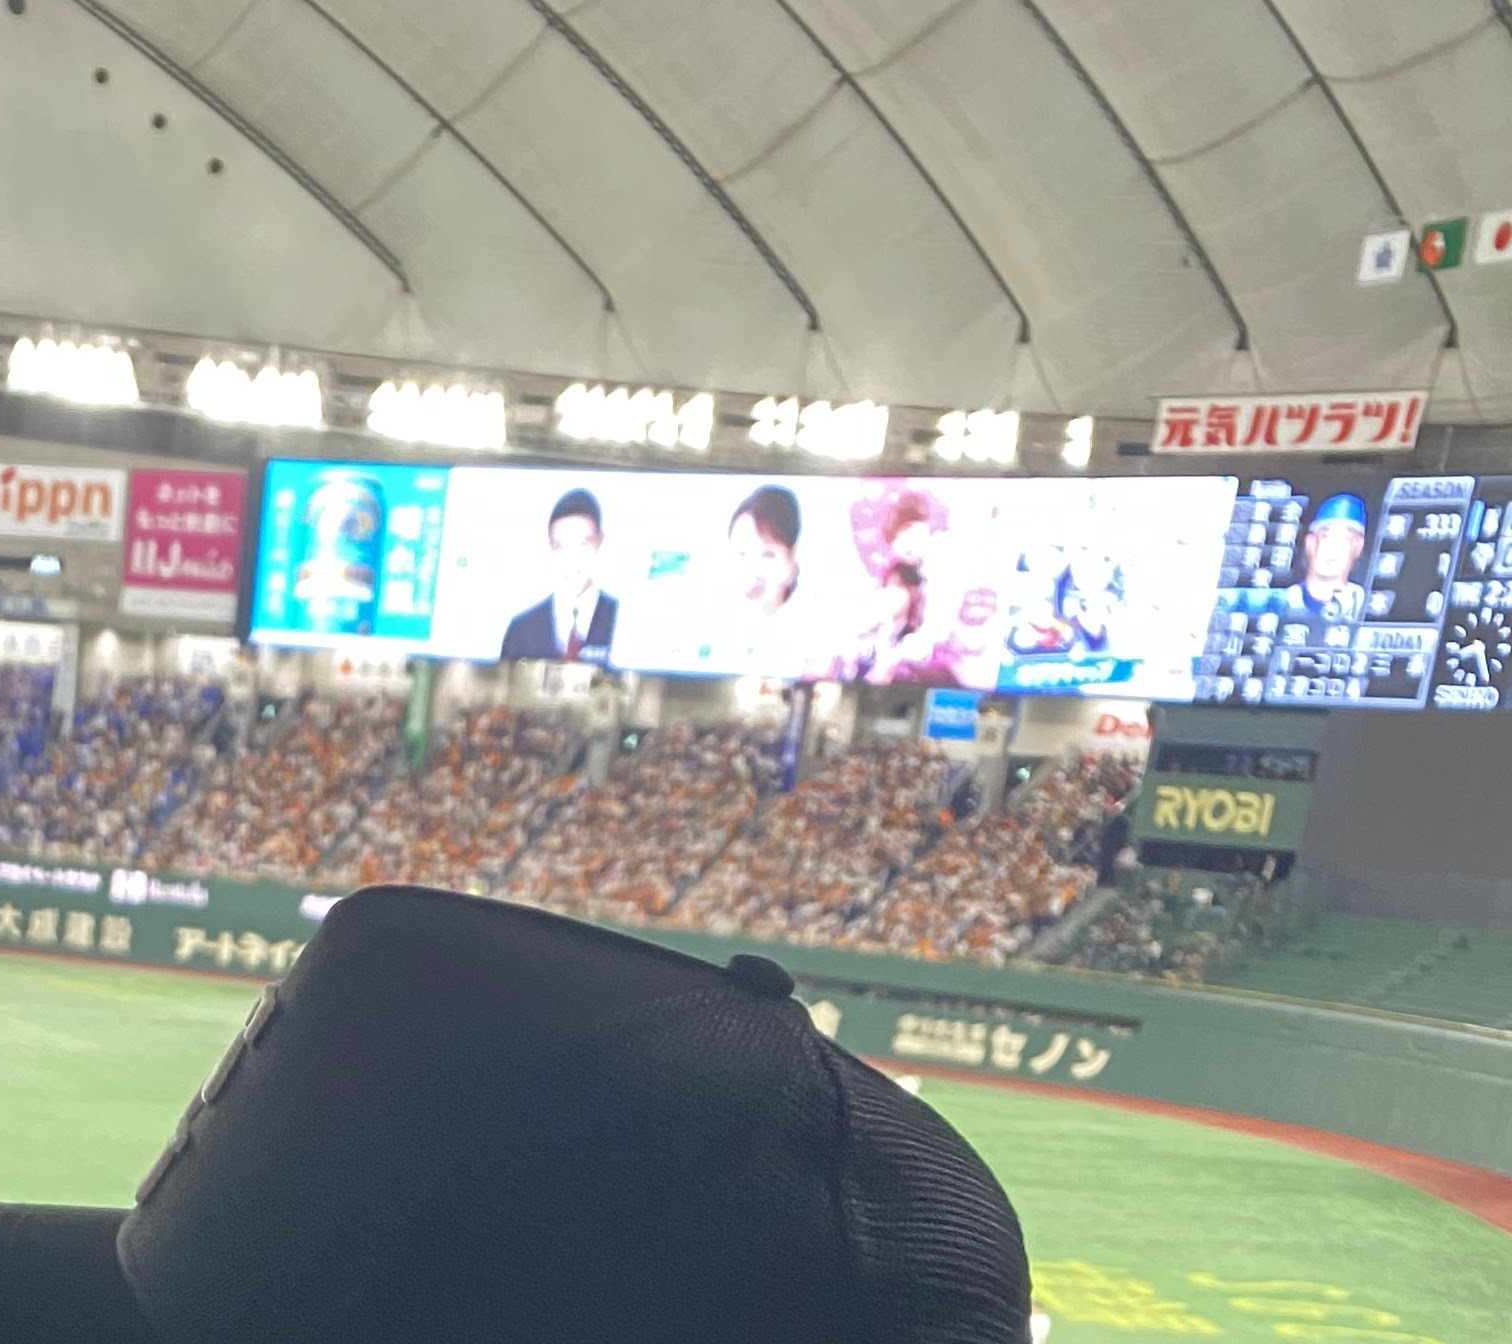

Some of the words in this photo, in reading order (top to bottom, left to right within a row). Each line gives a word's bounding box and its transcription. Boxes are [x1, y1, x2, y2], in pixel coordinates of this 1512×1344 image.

[1160, 397, 1421, 448] 元気ハツラツ!
[1154, 785, 1276, 837] RYOBI
